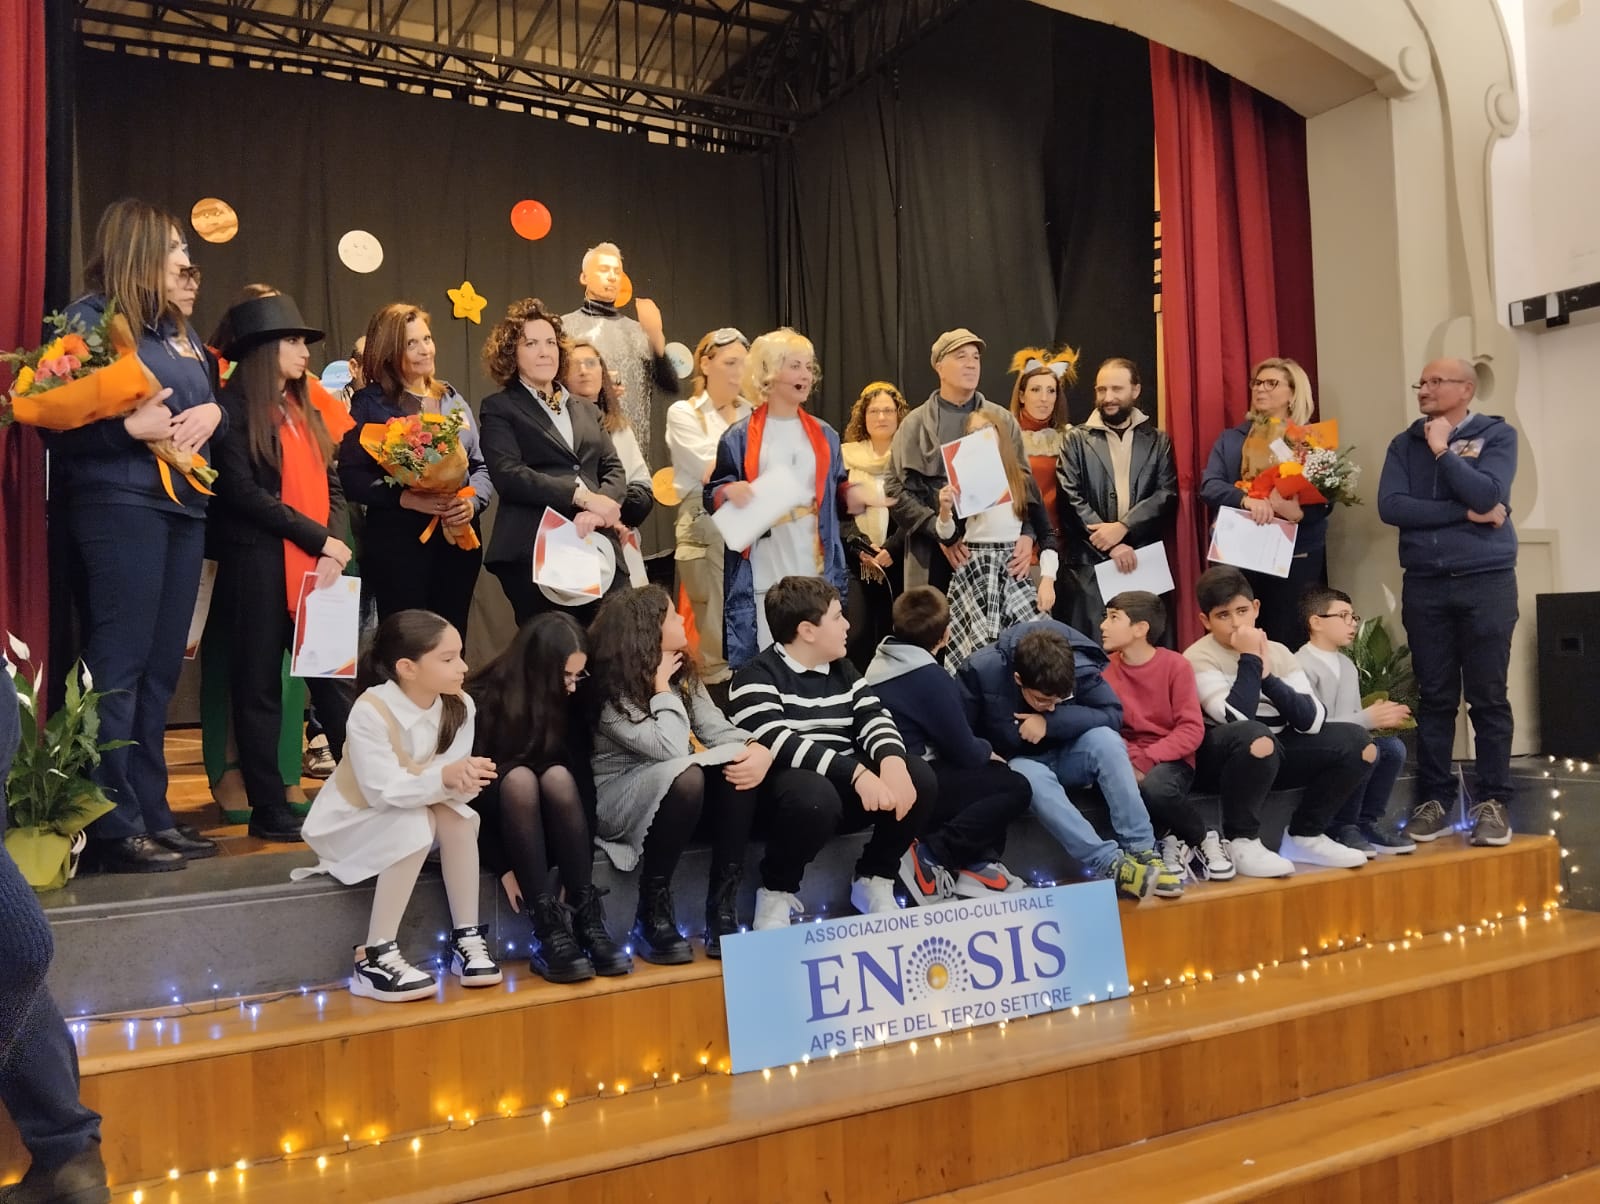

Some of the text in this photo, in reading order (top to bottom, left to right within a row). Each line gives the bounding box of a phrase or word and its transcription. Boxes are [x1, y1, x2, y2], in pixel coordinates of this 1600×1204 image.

[804, 894, 1055, 945] ASSOCIAZIONE SOCIO-CULTURALE
[810, 987, 1073, 1053] APS ENTE DEL TERZO SETTORE
